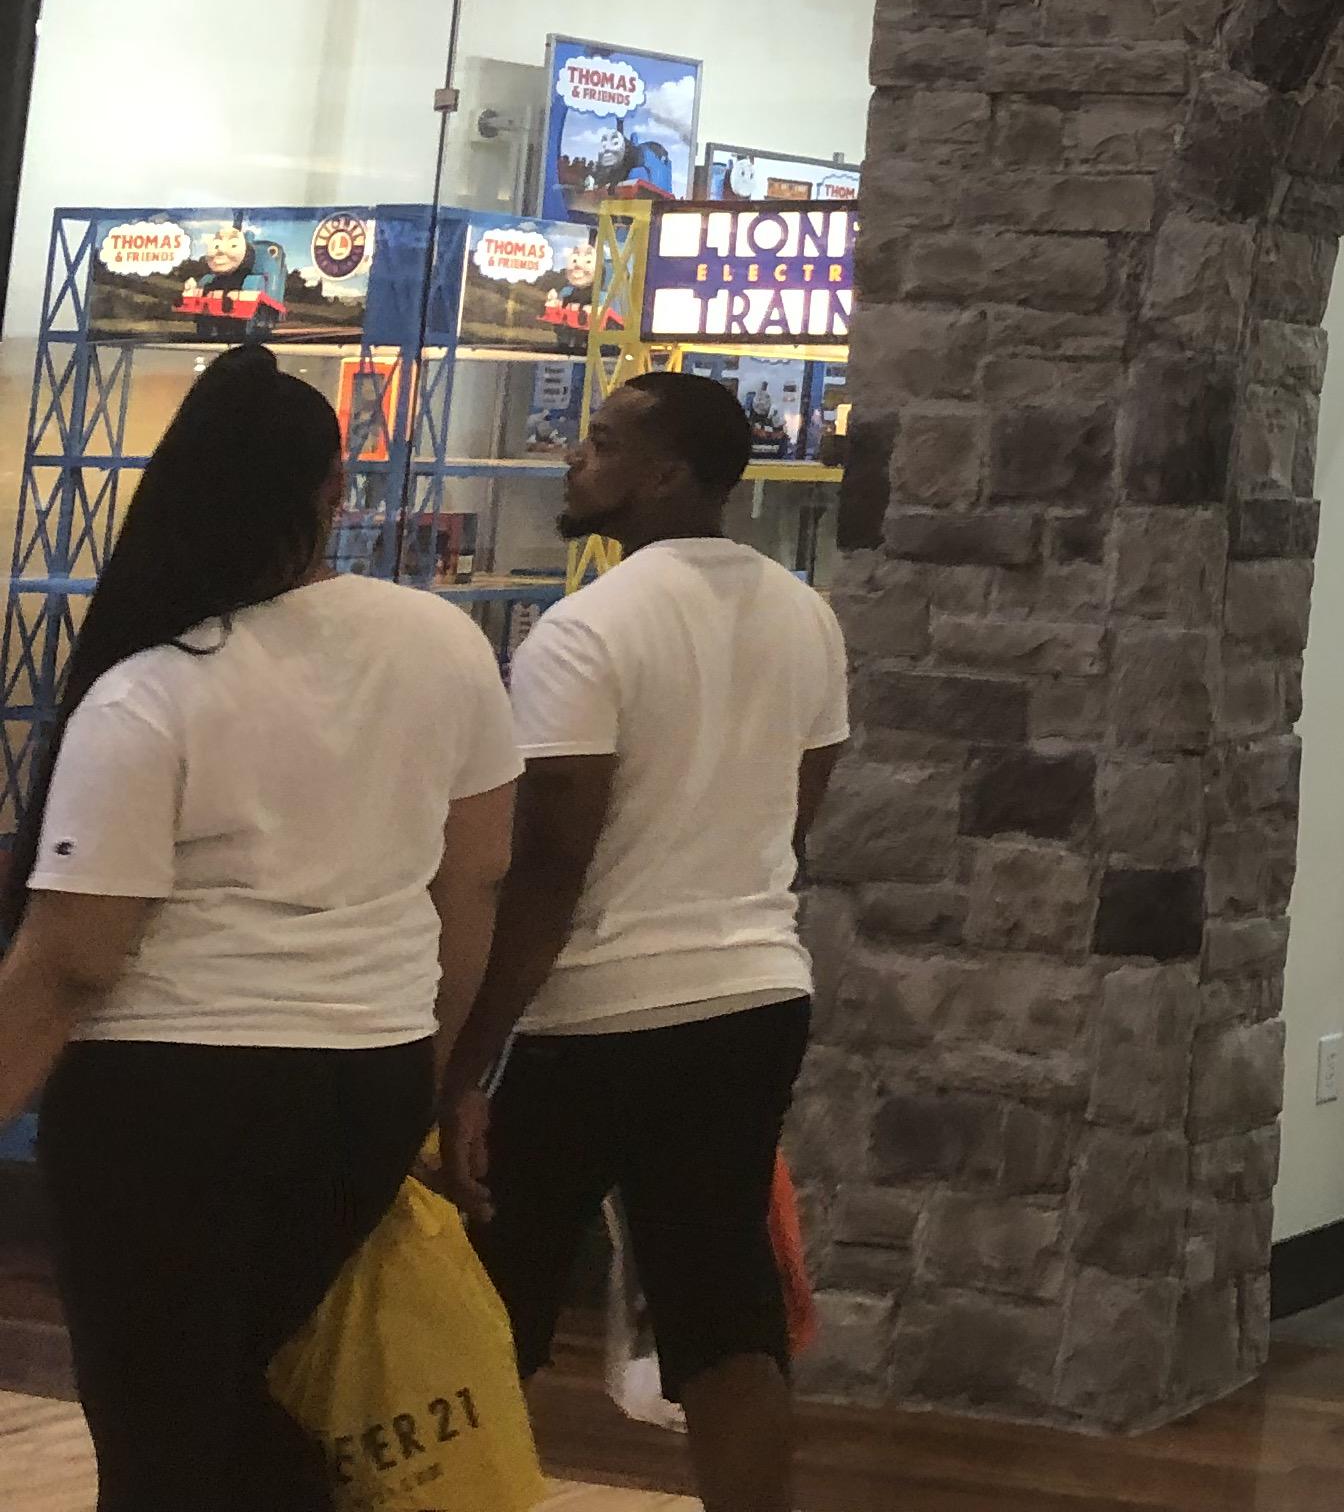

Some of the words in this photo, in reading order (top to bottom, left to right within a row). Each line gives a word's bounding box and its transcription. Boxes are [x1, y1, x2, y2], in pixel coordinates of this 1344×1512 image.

[567, 66, 637, 93] THOMAS
[571, 85, 579, 97] &
[583, 87, 631, 106] FRIENDS
[825, 184, 855, 199] THOM
[111, 234, 181, 250] THOMAS
[485, 239, 545, 259] THOMAS
[114, 251, 122, 263] &
[126, 251, 175, 263] FRIENDS
[497, 258, 539, 271] FRIENDS
[696, 264, 842, 282] ELECTR
[693, 288, 853, 335] TRAIN
[428, 1387, 480, 1442] 21
